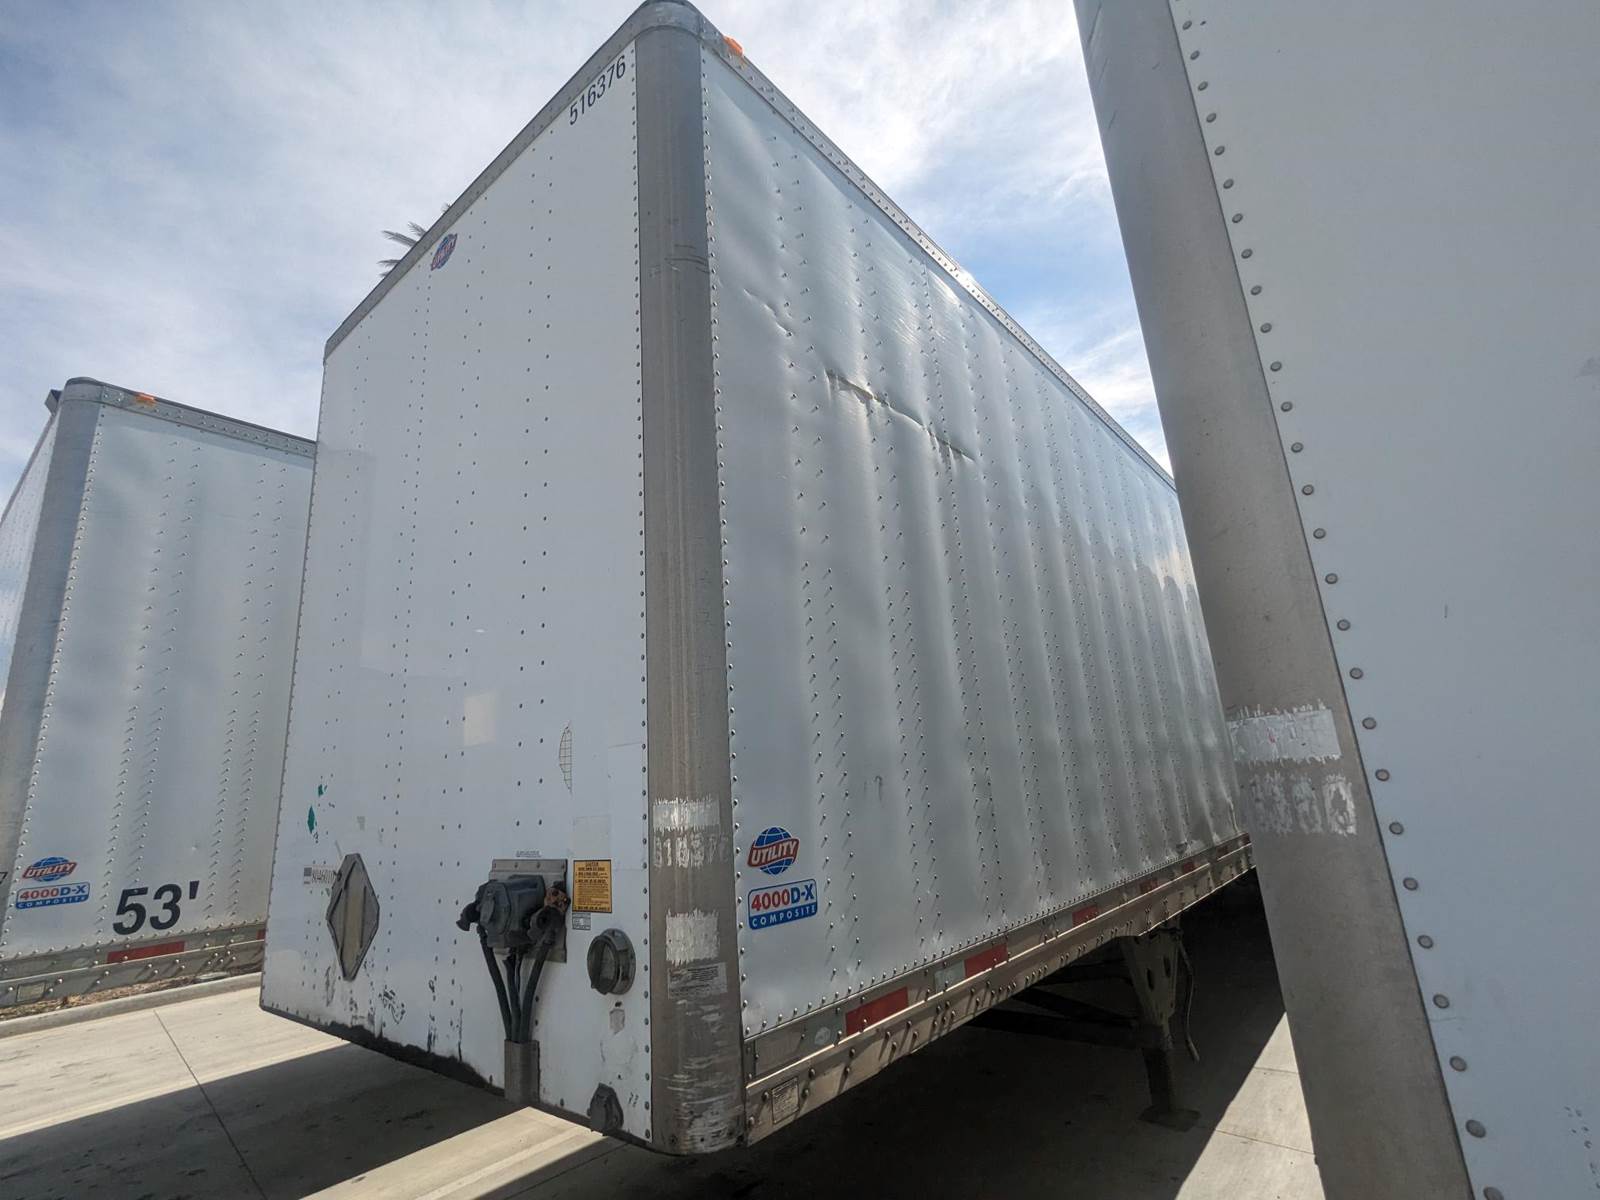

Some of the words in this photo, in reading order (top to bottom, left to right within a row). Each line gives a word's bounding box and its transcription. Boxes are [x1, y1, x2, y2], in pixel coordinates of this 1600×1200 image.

[569, 54, 626, 126] 516376
[751, 840, 798, 865] UTILITY
[26, 862, 75, 877] UTILITY
[19, 884, 88, 900] 4000D-X
[751, 883, 815, 912] 4000D-X
[112, 880, 200, 935] 53'
[751, 904, 816, 927] COMPOSITE
